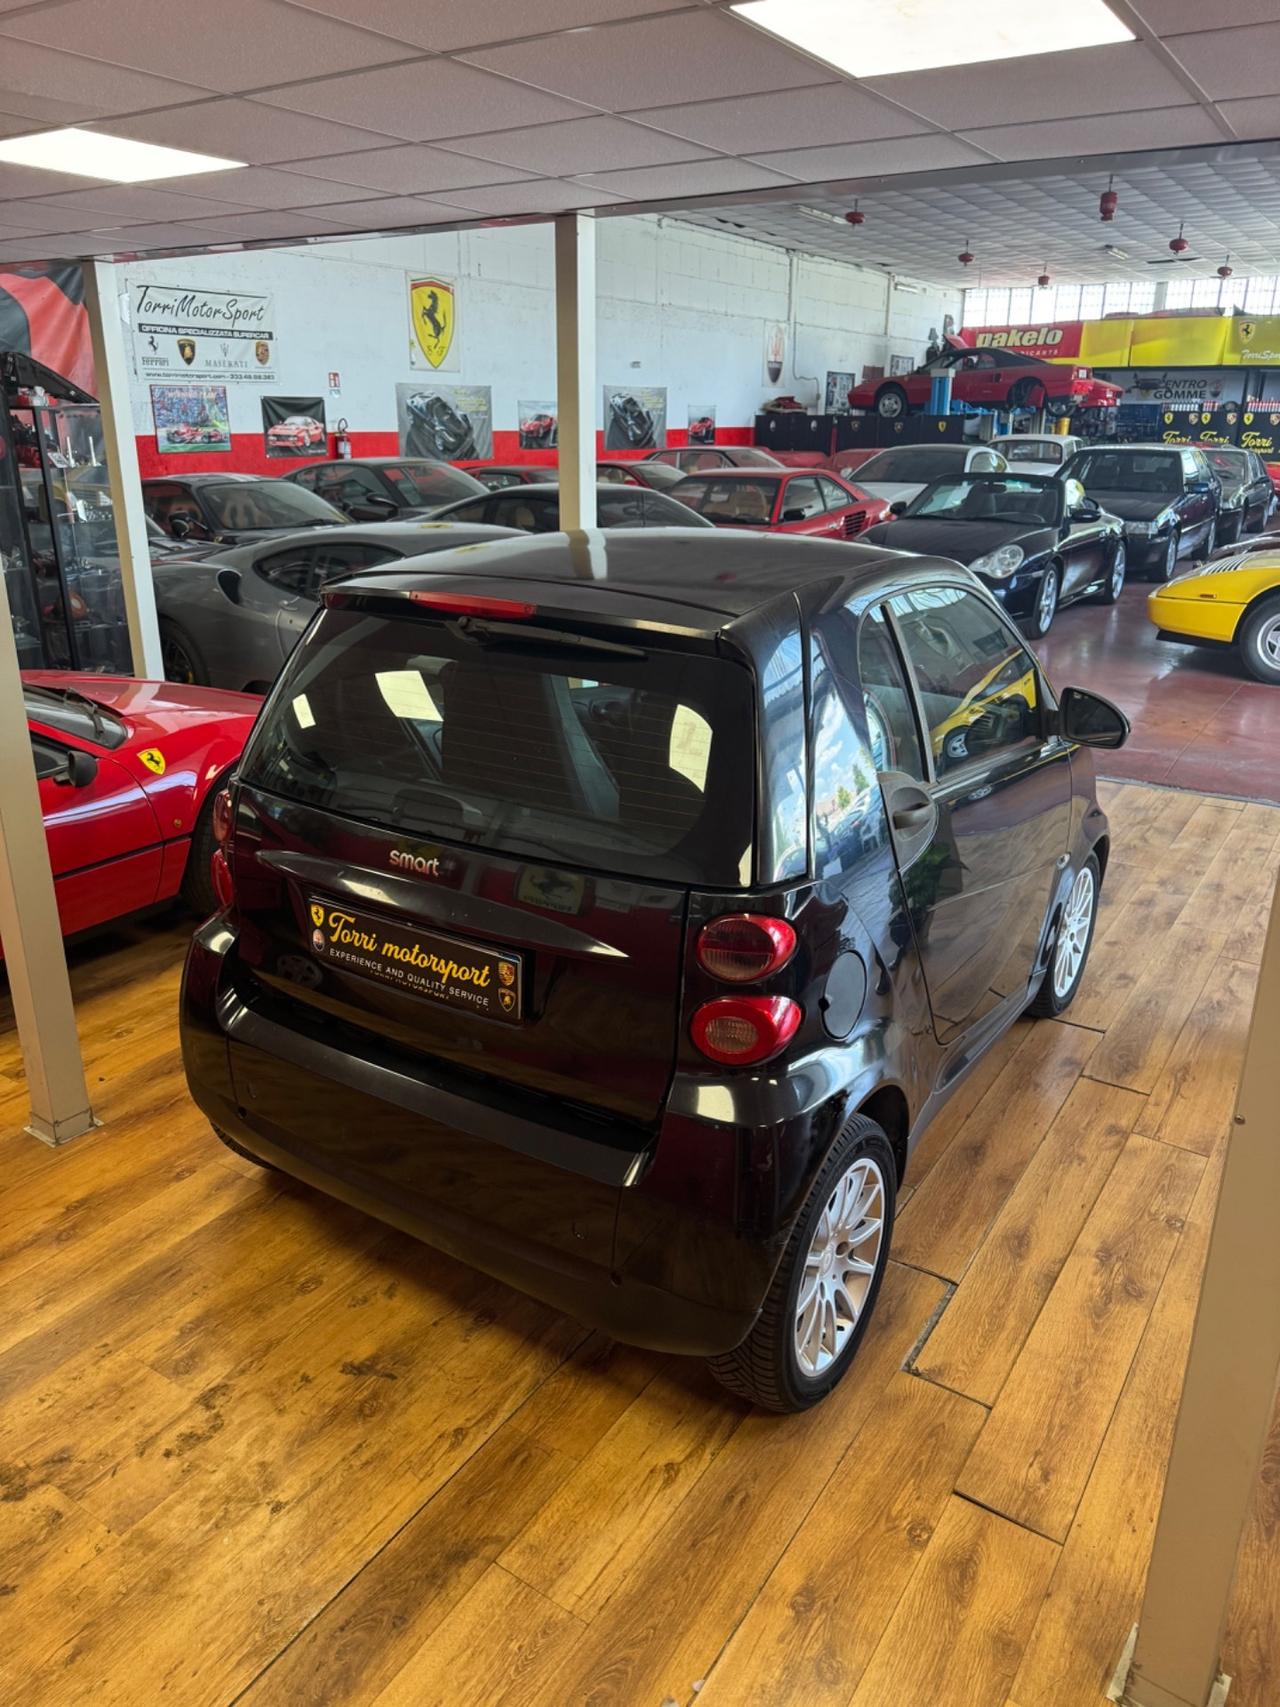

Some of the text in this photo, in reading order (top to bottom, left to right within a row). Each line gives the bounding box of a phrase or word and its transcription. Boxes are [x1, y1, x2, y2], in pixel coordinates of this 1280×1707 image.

[136, 285, 267, 328] TorriMotorSport
[141, 325, 177, 334] OFFICINA
[178, 327, 233, 337] SPECIALIZZATA
[1153, 389, 1207, 399] GOMME
[1166, 379, 1208, 389] ENTRO
[1241, 431, 1272, 447] Torri
[389, 849, 439, 876] smart
[328, 911, 378, 951] Torri
[381, 944, 491, 987] motorsport
[329, 947, 382, 972] EXPERIENCE
[385, 965, 404, 979] AND
[407, 973, 446, 991] QUALITY
[449, 986, 489, 1006] SERVICE
